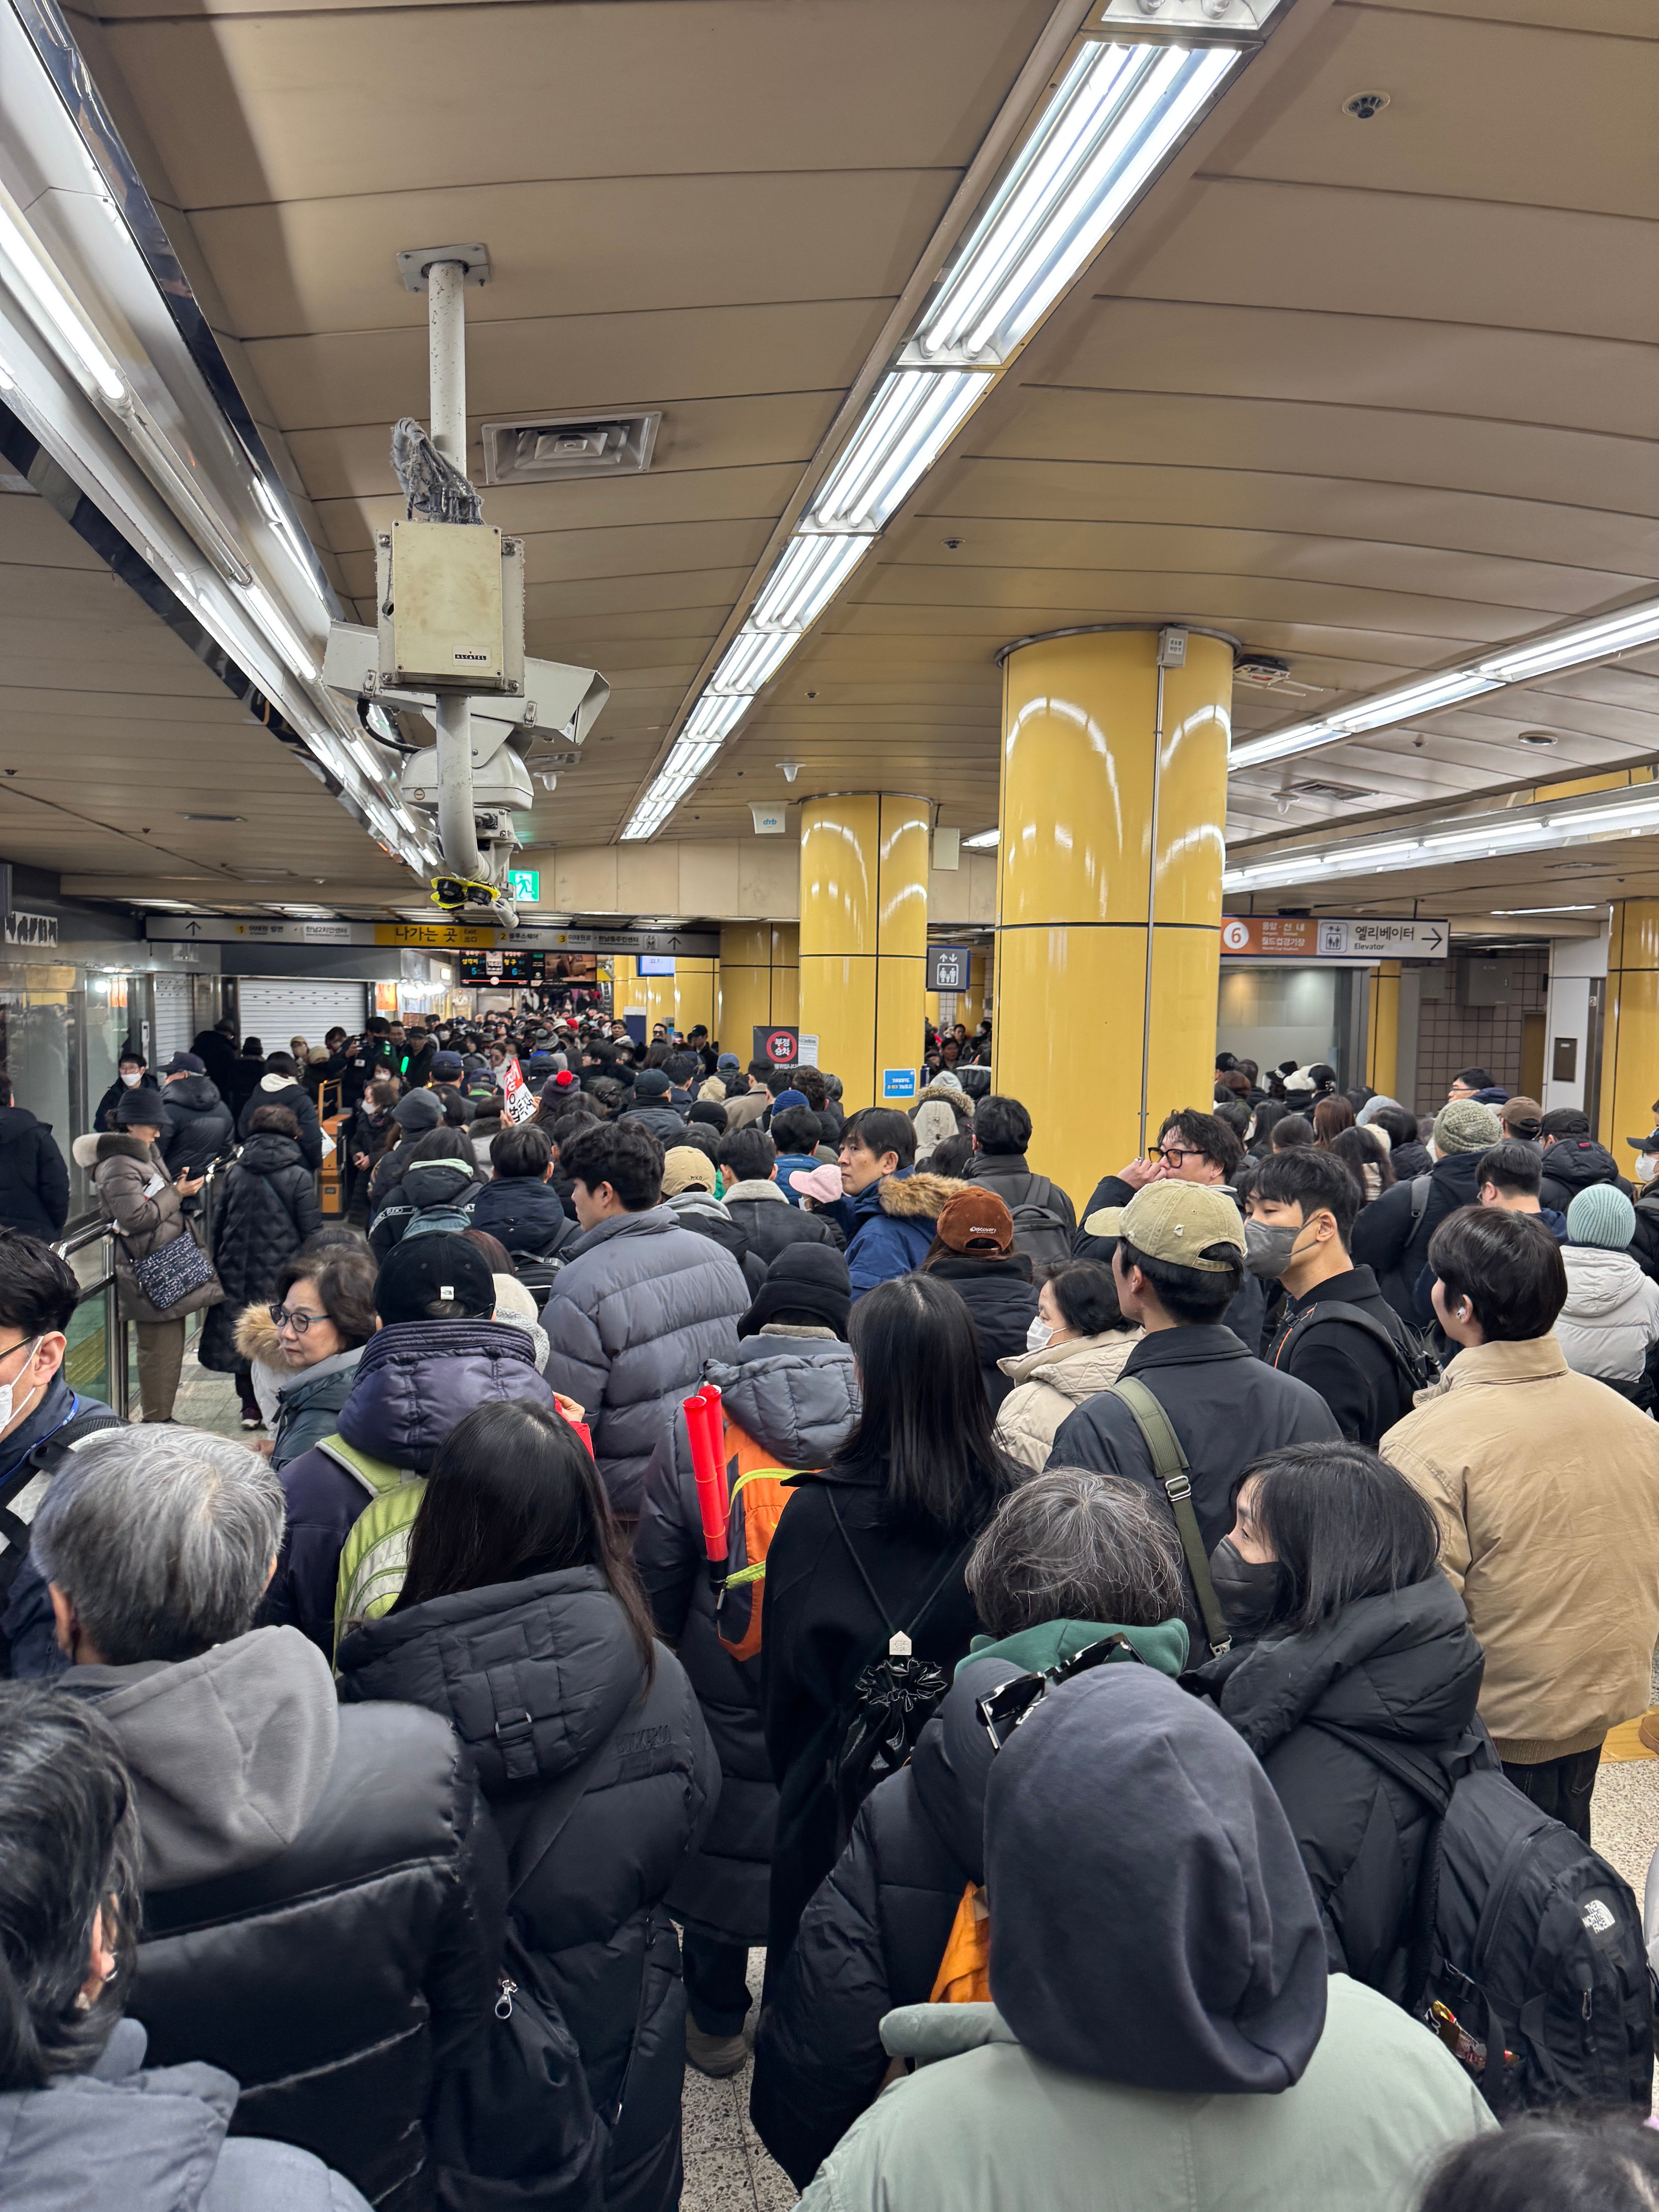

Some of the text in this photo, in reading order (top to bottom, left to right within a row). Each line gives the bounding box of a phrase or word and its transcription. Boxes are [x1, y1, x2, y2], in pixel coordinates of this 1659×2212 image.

[1262, 922, 1277, 930] 응암
[396, 926, 457, 943] 나가는 곳
[1231, 927, 1241, 943] 6
[1355, 926, 1414, 941] 엘리베이터
[1262, 937, 1305, 946] 월드컵경기장
[775, 1038, 790, 1046] 부정
[775, 1047, 790, 1056] 승차
[1584, 1902, 1598, 1914] THE
[1592, 1918, 1607, 1934] FACE
